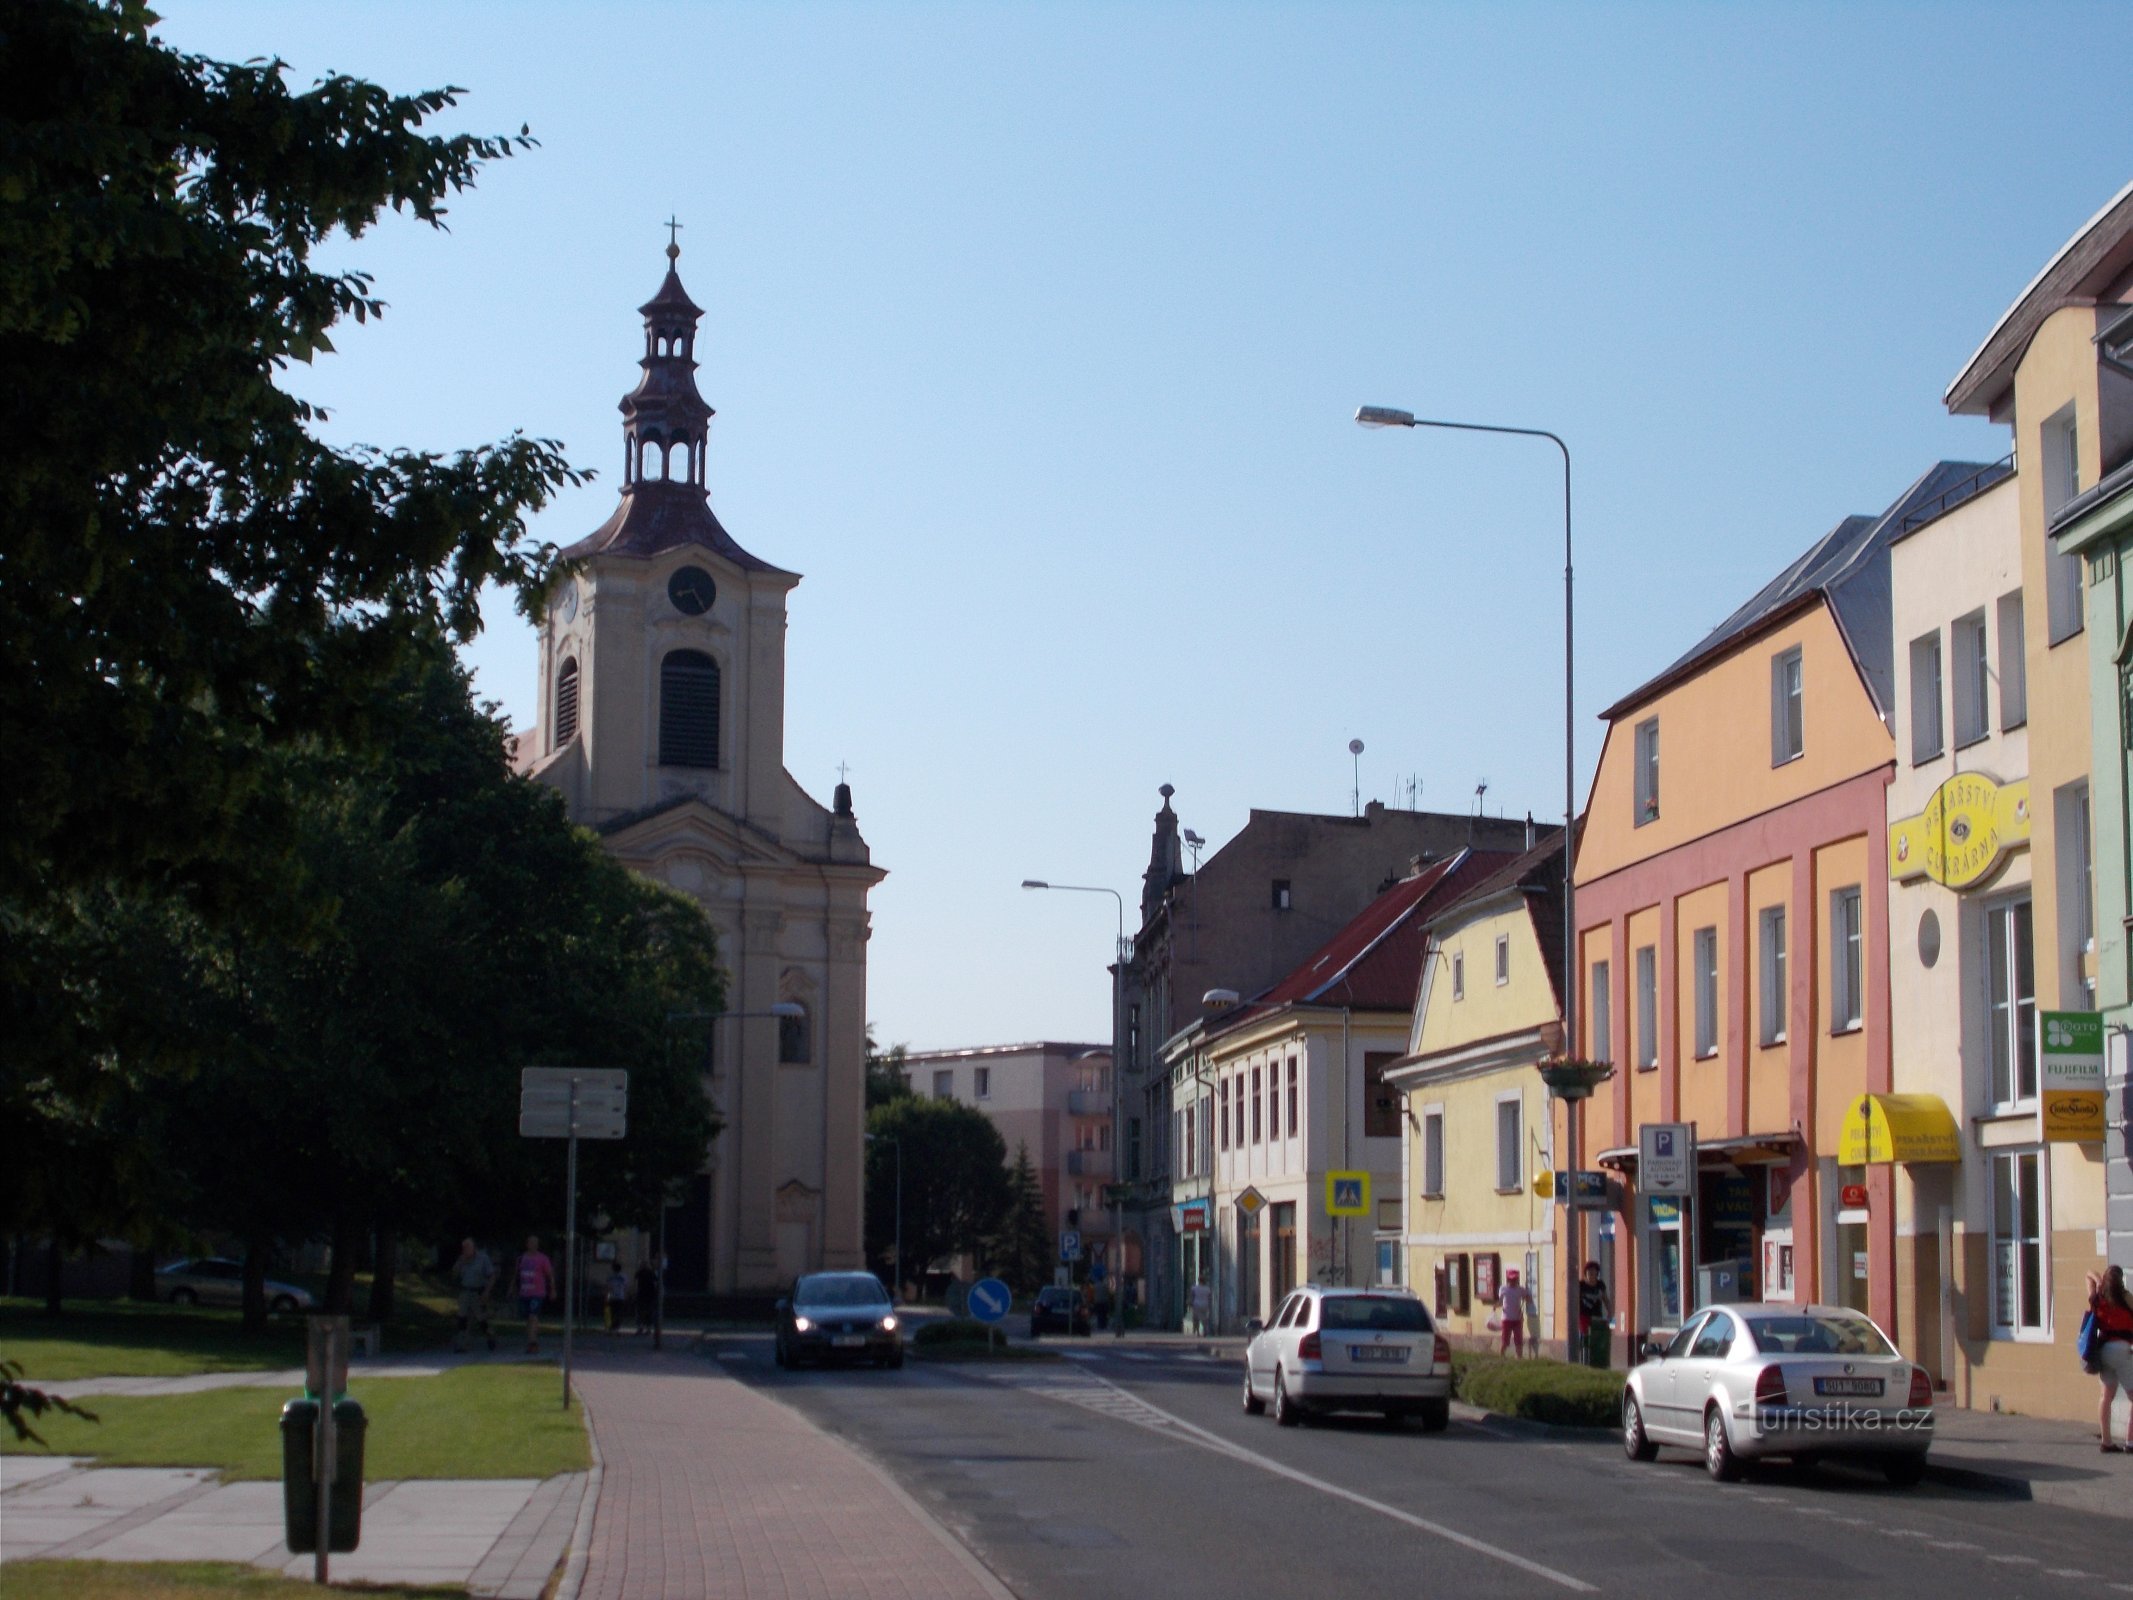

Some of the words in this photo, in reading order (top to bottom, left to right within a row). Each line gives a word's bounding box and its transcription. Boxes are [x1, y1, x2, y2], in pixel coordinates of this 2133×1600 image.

[2047, 1064, 2098, 1074] FUJIFILM
[1658, 1133, 1670, 1150] P
[1719, 1272, 1731, 1288] P
